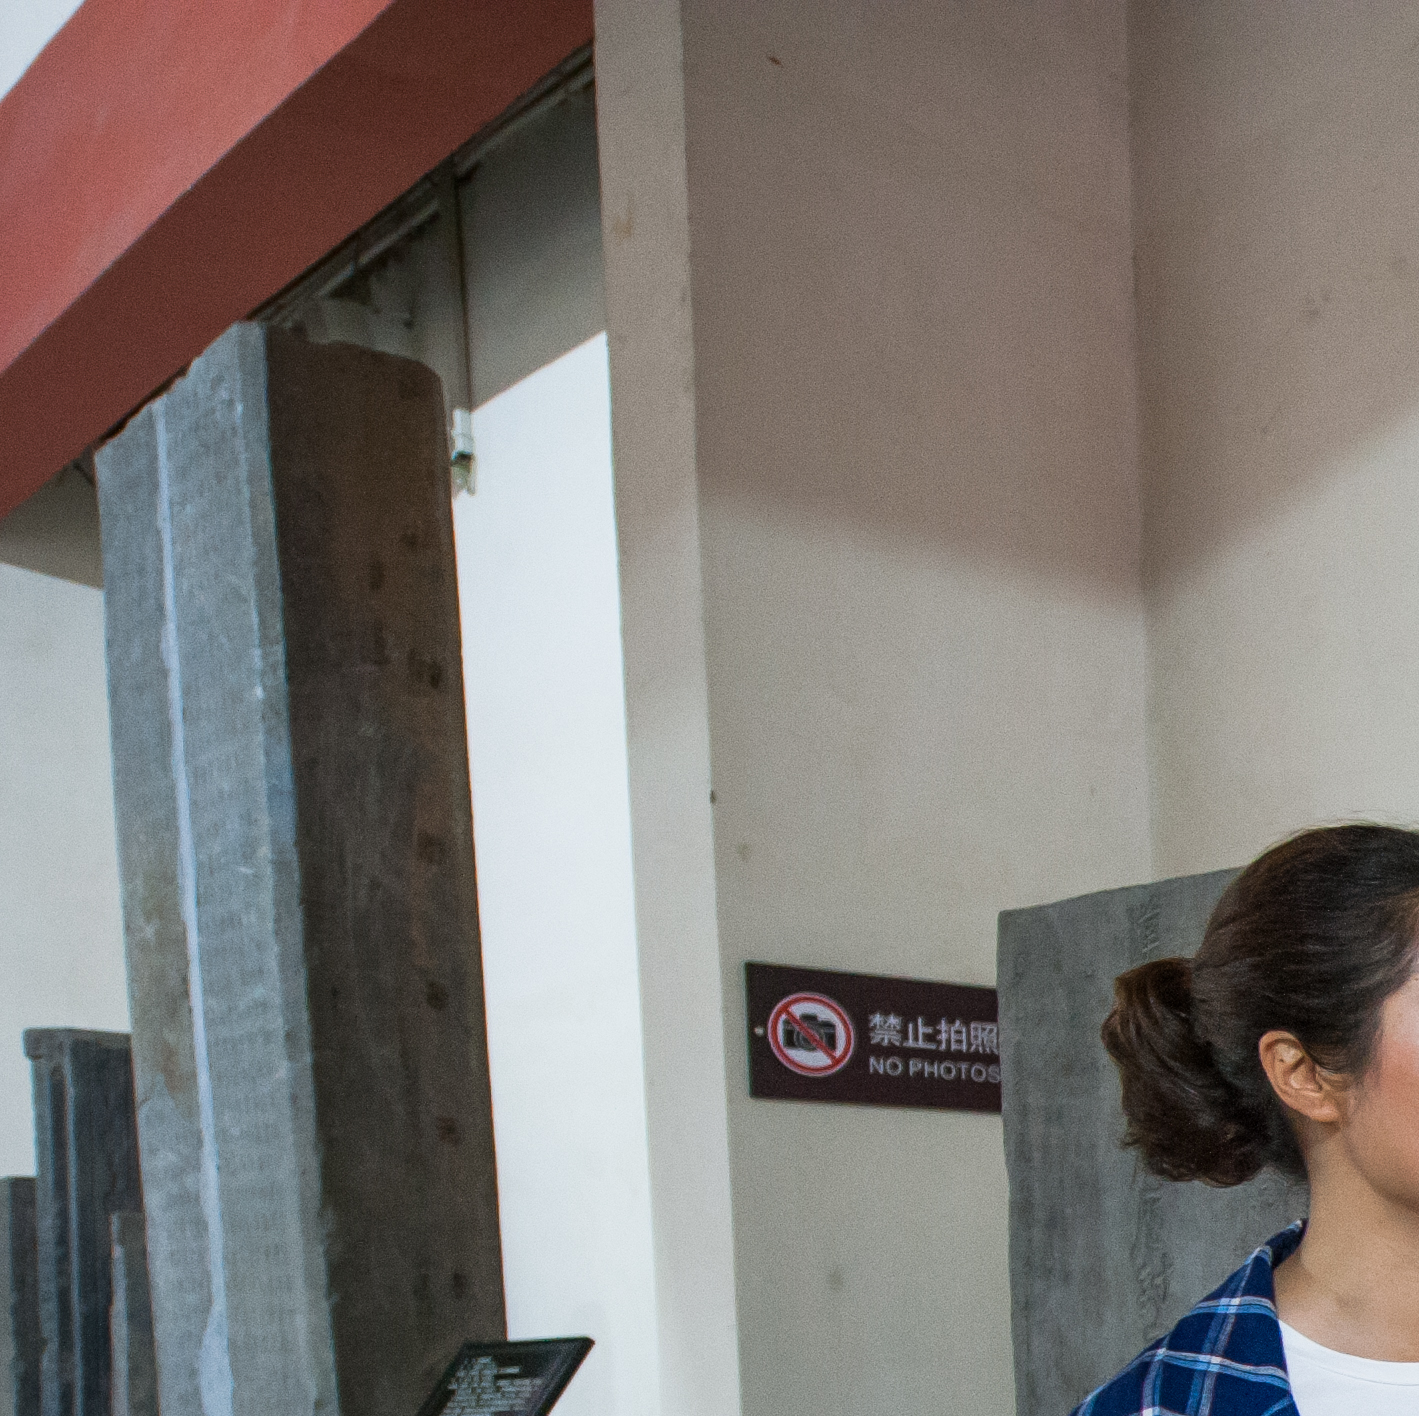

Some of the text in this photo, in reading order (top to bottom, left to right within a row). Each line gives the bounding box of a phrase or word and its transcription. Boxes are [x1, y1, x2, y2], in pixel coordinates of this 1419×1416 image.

[868, 1013, 999, 1056] 禁止拍照
[868, 1056, 902, 1076] NO
